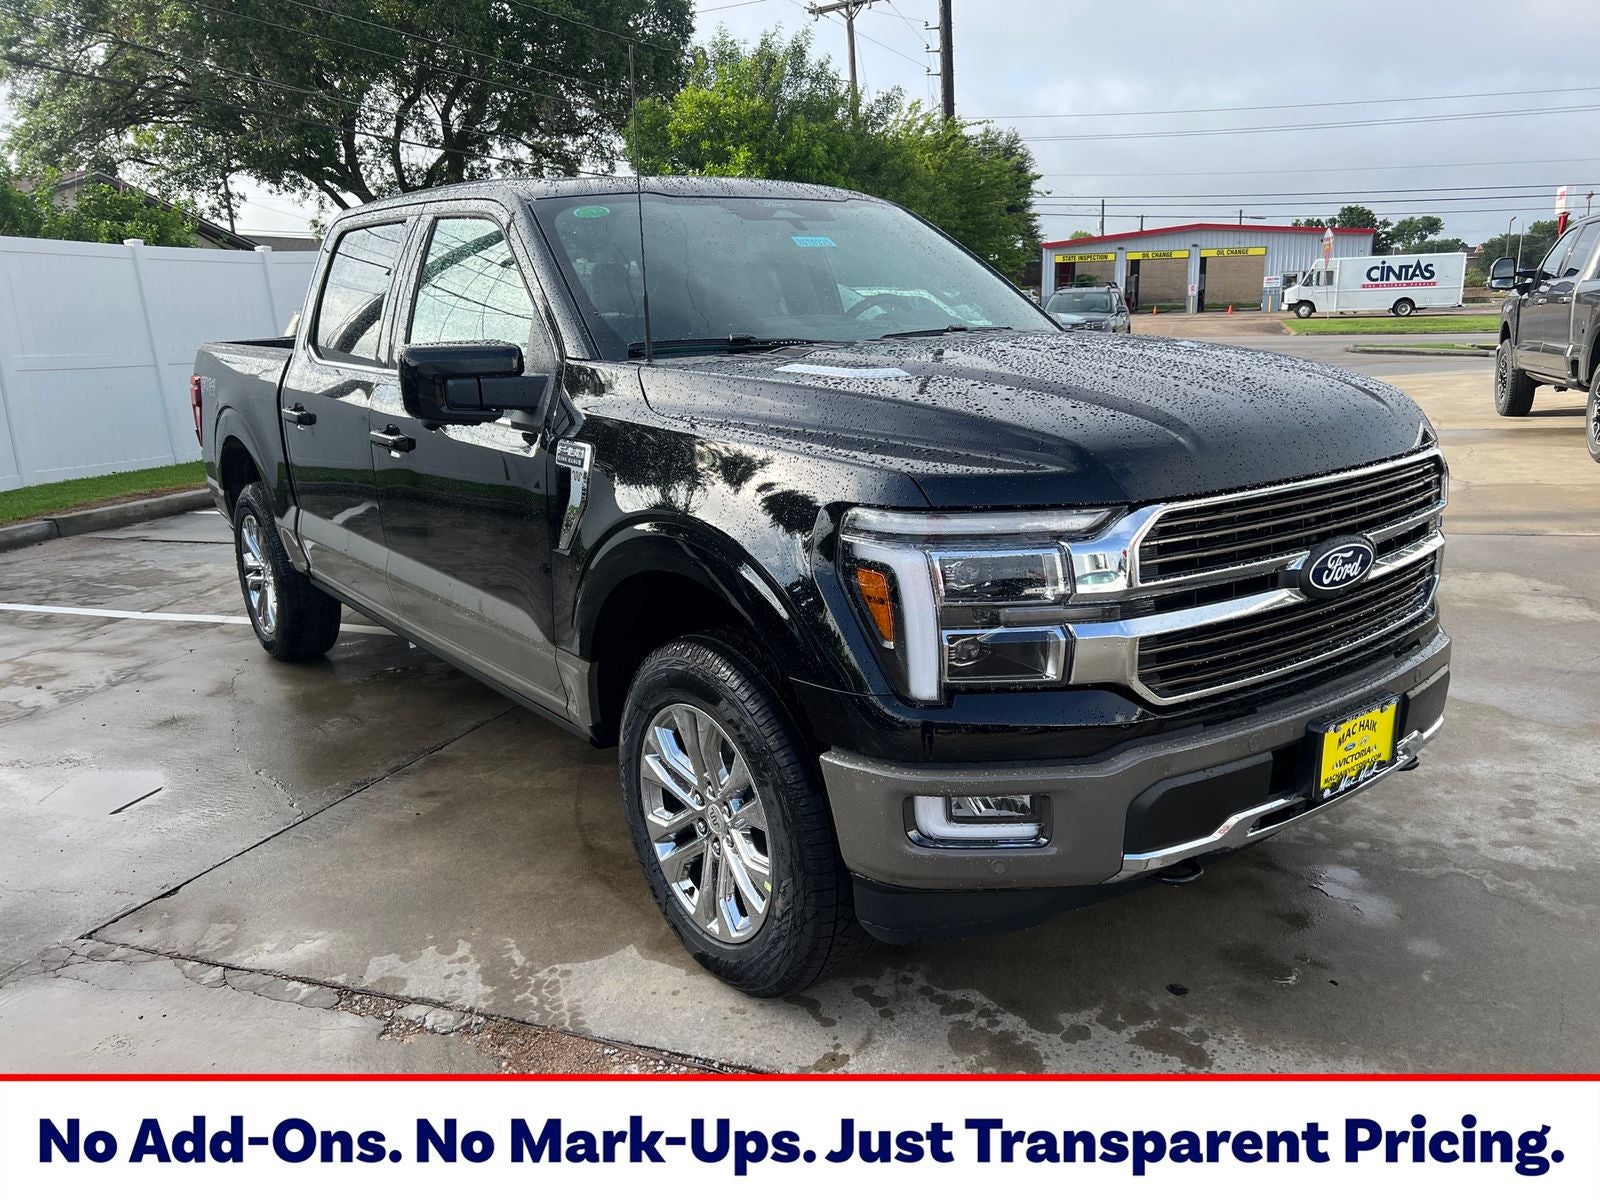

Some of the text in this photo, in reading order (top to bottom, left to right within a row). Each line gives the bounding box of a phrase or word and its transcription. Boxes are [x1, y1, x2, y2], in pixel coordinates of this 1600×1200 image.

[1141, 251, 1151, 259] OIL
[1226, 248, 1249, 256] CHANGE
[1322, 550, 1363, 585] Ford
[1336, 722, 1358, 750] MAC
[1358, 719, 1378, 733] HAIK
[1338, 745, 1372, 768] VICTORIA
